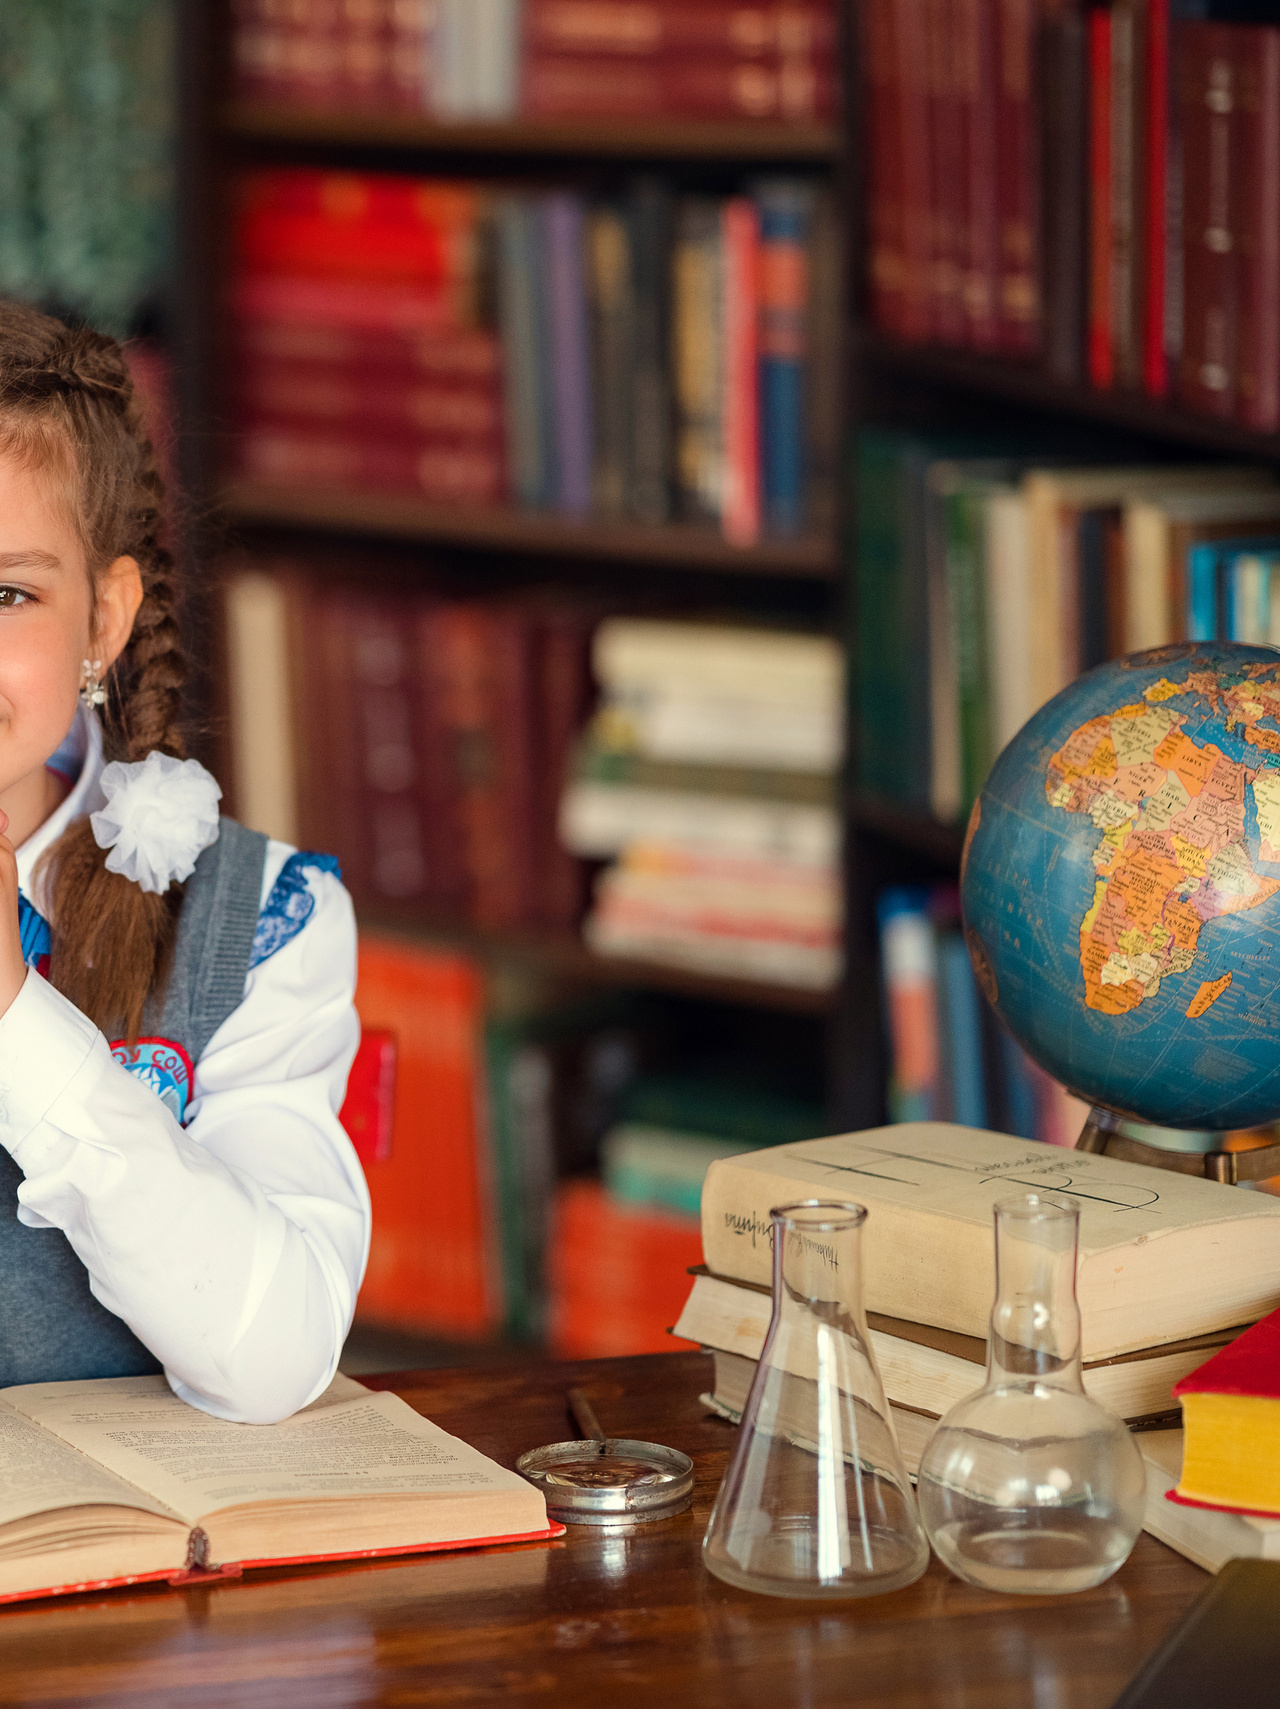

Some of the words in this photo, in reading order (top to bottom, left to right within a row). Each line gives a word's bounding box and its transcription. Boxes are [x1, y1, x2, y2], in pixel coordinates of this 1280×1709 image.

[1182, 754, 1202, 767] LIBYA
[1128, 770, 1148, 783] NIGER
[1210, 778, 1237, 790] EGYPT
[1160, 790, 1180, 801] CHAD
[1182, 846, 1206, 860] SOUTH
[1211, 866, 1246, 884] ETHIOPIA
[1249, 884, 1280, 905] SOMALIA
[1164, 917, 1200, 934] TANZANIA
[1230, 951, 1271, 961] SEYCHELLES
[1194, 976, 1232, 1015] MADAGASCAR
